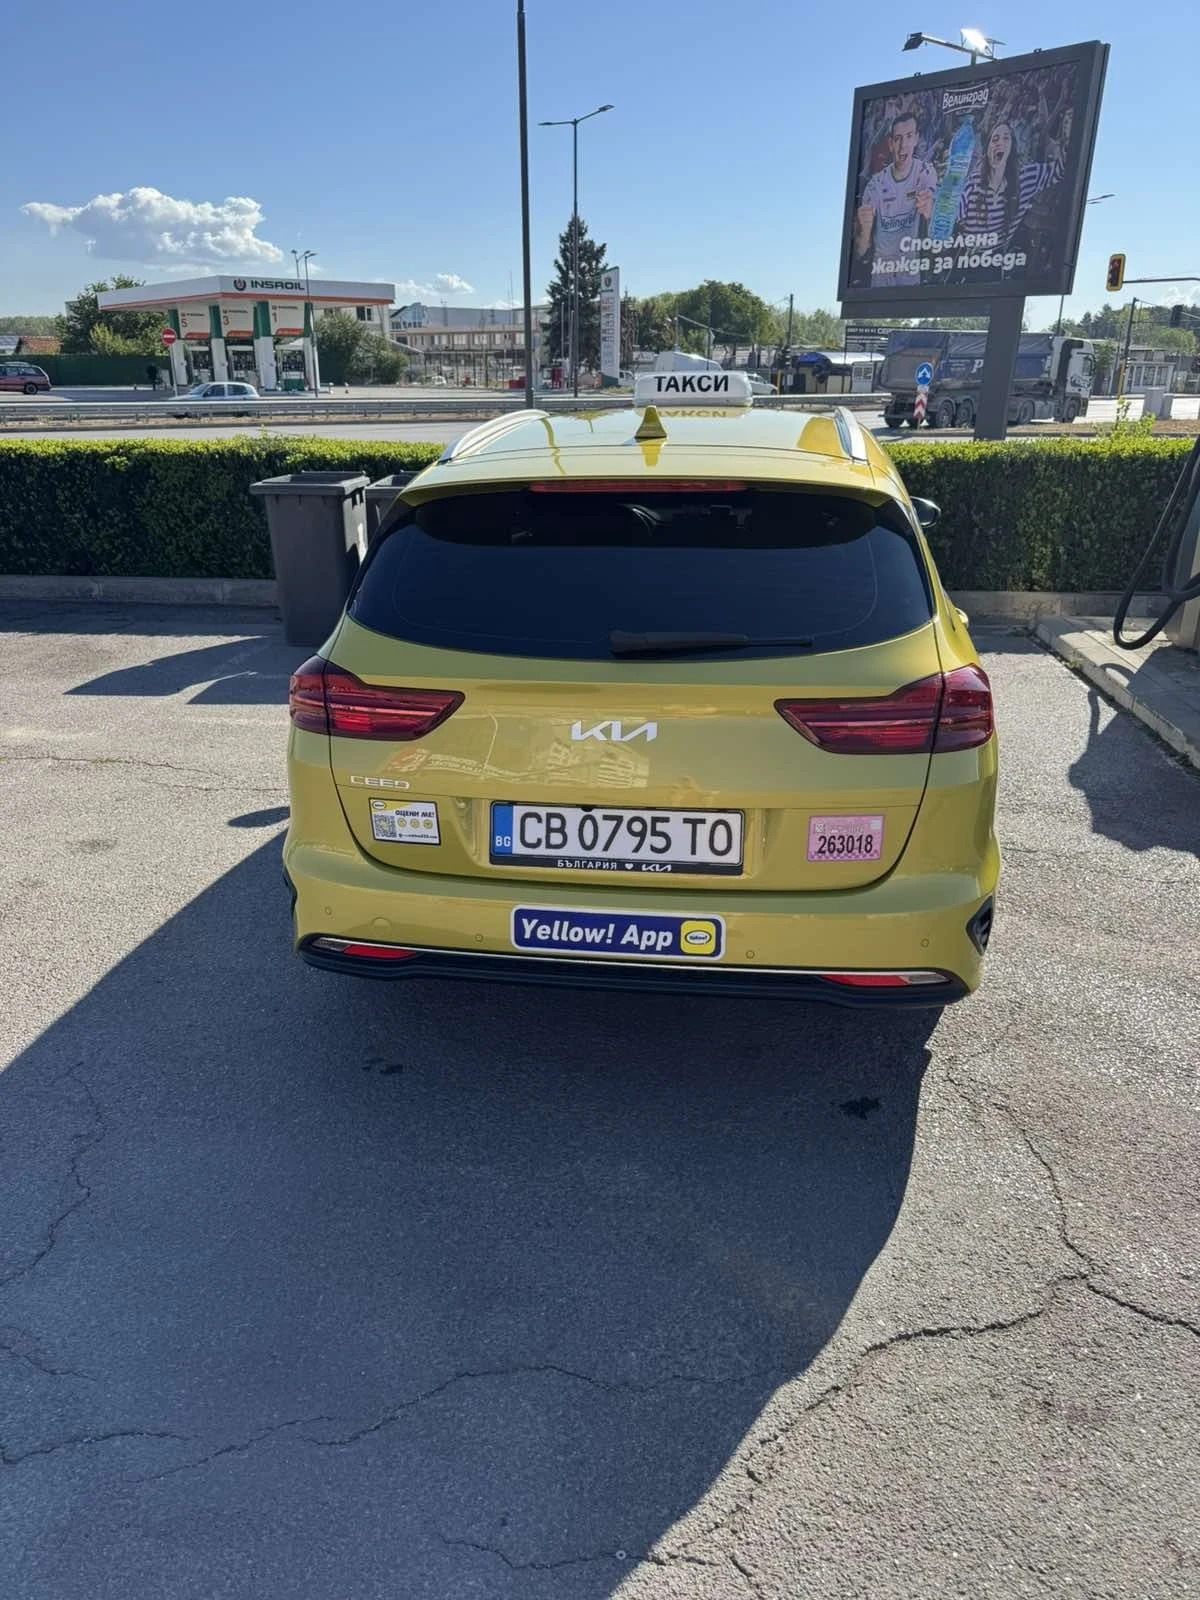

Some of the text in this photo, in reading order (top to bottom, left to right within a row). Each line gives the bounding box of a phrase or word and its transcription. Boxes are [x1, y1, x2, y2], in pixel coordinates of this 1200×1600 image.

[900, 232, 999, 253] Споделена
[871, 250, 1027, 275] жажда за победа
[654, 375, 729, 392] ТАКСИ
[571, 720, 658, 742] KIA
[495, 836, 511, 848] BG
[578, 813, 672, 854] 0795
[817, 834, 873, 854] 263018
[557, 859, 672, 872] БЪЛГАРИЯ KIA
[521, 918, 673, 950] Yellow! App
